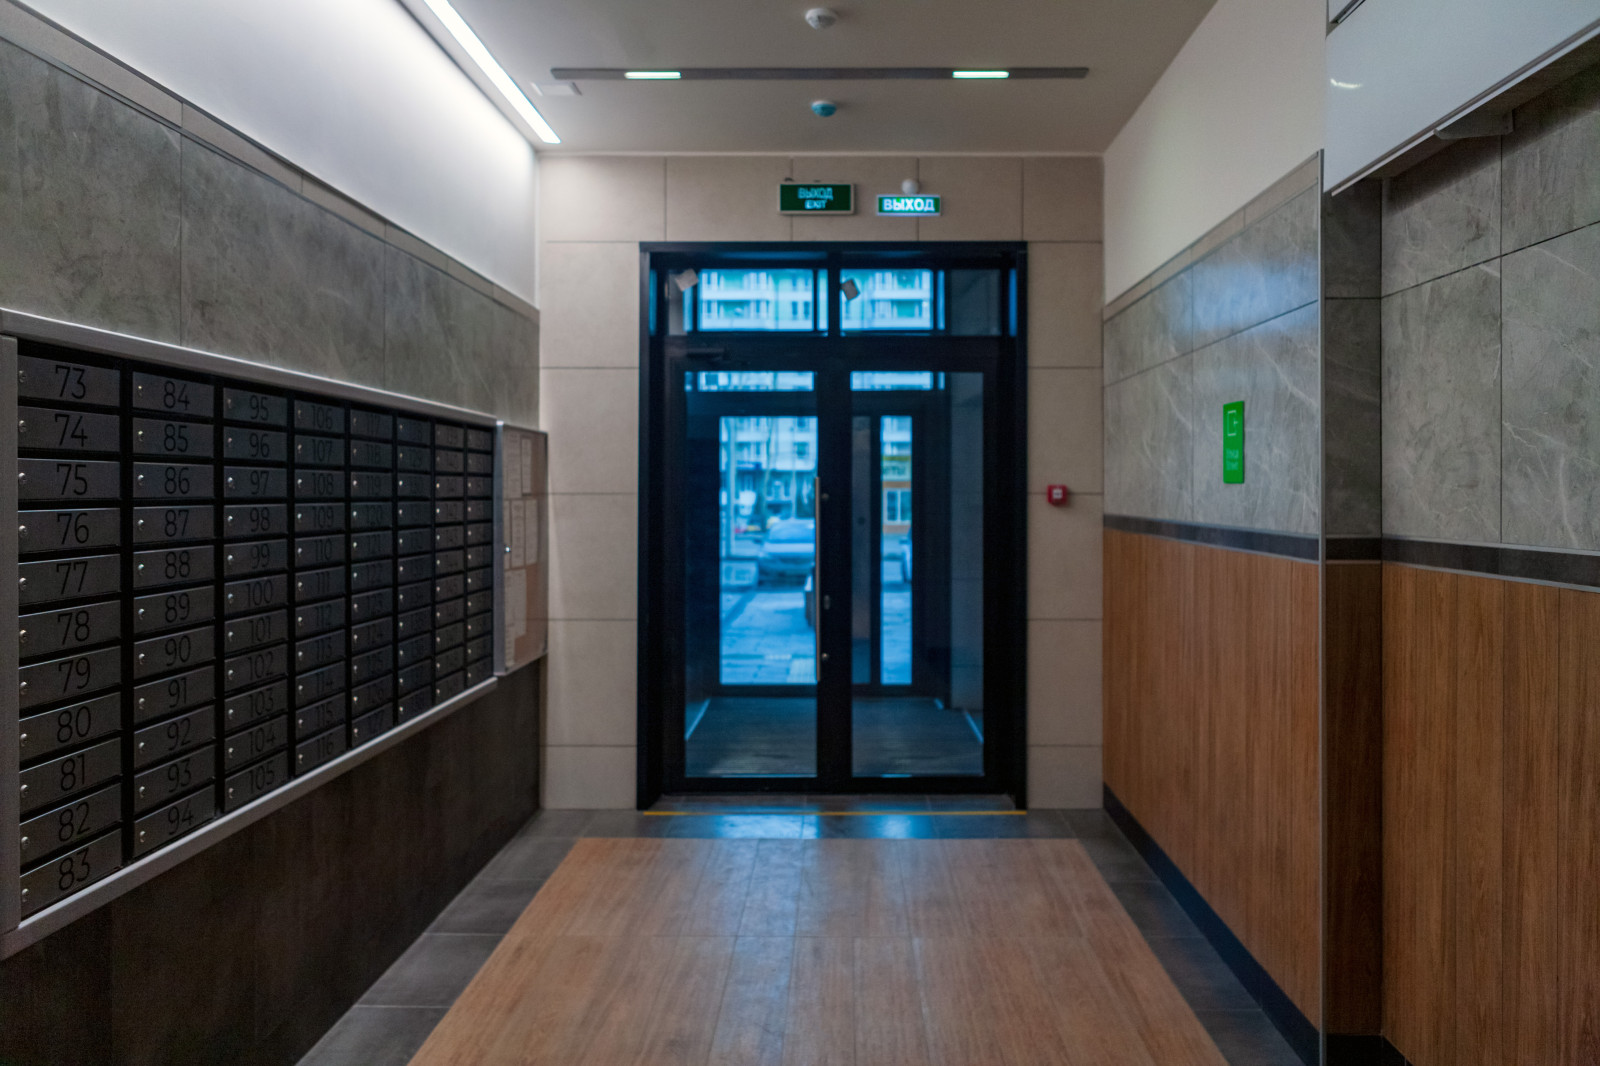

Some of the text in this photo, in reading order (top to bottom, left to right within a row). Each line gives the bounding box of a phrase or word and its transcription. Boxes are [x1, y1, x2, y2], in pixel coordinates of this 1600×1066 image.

[798, 188, 833, 199] ВЫХОД
[805, 200, 827, 209] EXIT
[883, 198, 935, 211] ВЫХОД
[55, 366, 86, 400] 73
[163, 381, 190, 410] 84
[250, 395, 268, 420] 95
[311, 405, 333, 430] 106
[54, 414, 88, 447] 74
[164, 424, 188, 452] 85
[250, 433, 270, 457] 96
[312, 439, 333, 462] 107
[56, 464, 88, 496] 75
[164, 466, 190, 494] 86
[250, 470, 270, 495] 97
[312, 473, 334, 495] 108
[57, 512, 89, 545] 76
[164, 509, 190, 537] 87
[250, 507, 270, 532] 98
[312, 506, 334, 528] 109
[251, 544, 270, 570] 99
[314, 538, 333, 560] 110
[56, 561, 88, 594] 77
[165, 550, 190, 579] 88
[246, 580, 272, 606] 100
[165, 592, 190, 623] 89
[57, 610, 90, 645] 78
[249, 616, 271, 641] 101
[165, 636, 191, 666] 90
[58, 657, 91, 693] 79
[248, 652, 274, 679] 102
[168, 678, 187, 708] 91
[249, 690, 274, 717] 103
[57, 706, 91, 743] 80
[167, 718, 191, 751] 92
[249, 728, 275, 755] 104
[60, 755, 86, 791] 81
[168, 762, 191, 793] 93
[249, 766, 274, 792] 105
[59, 802, 90, 842] 82
[168, 805, 193, 836] 94
[59, 848, 90, 891] 83
